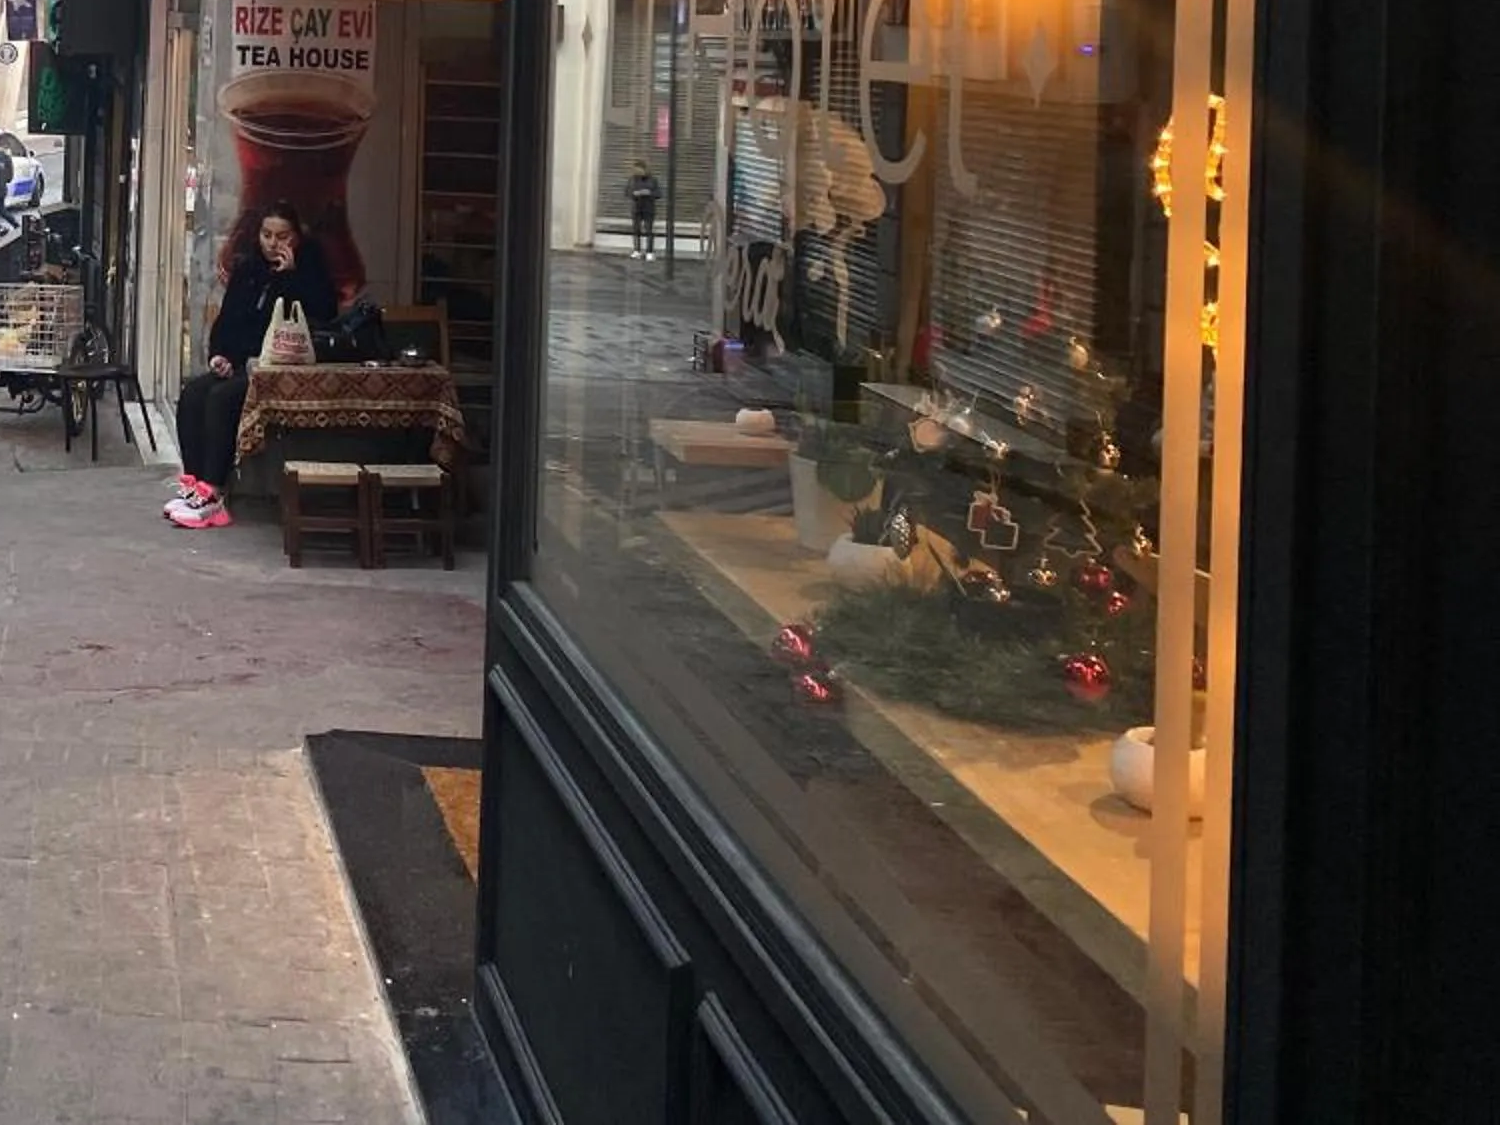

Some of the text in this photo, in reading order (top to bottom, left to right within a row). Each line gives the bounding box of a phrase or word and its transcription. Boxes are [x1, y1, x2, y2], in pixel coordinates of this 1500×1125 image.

[235, 0, 373, 44] RİZE ÇAY EVİ
[236, 45, 370, 70] TEA HOUSE
